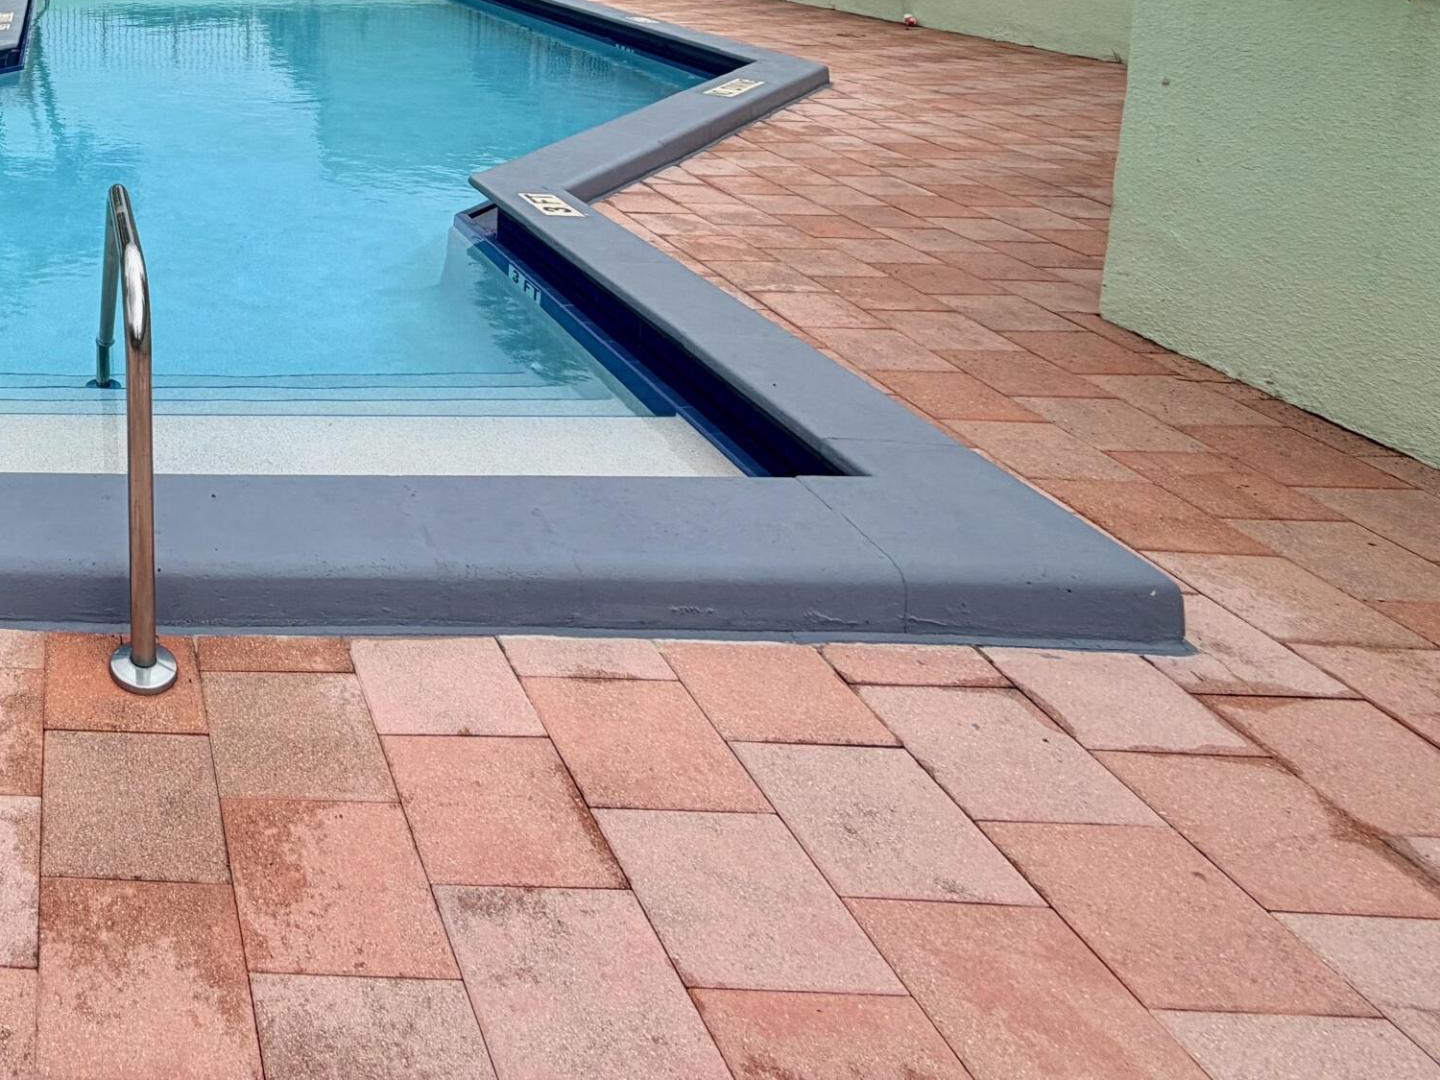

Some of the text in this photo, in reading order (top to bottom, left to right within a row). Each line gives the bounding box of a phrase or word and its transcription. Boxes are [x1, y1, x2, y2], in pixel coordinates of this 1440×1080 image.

[523, 193, 572, 214] 3 FT
[511, 270, 542, 301] 3 FT
